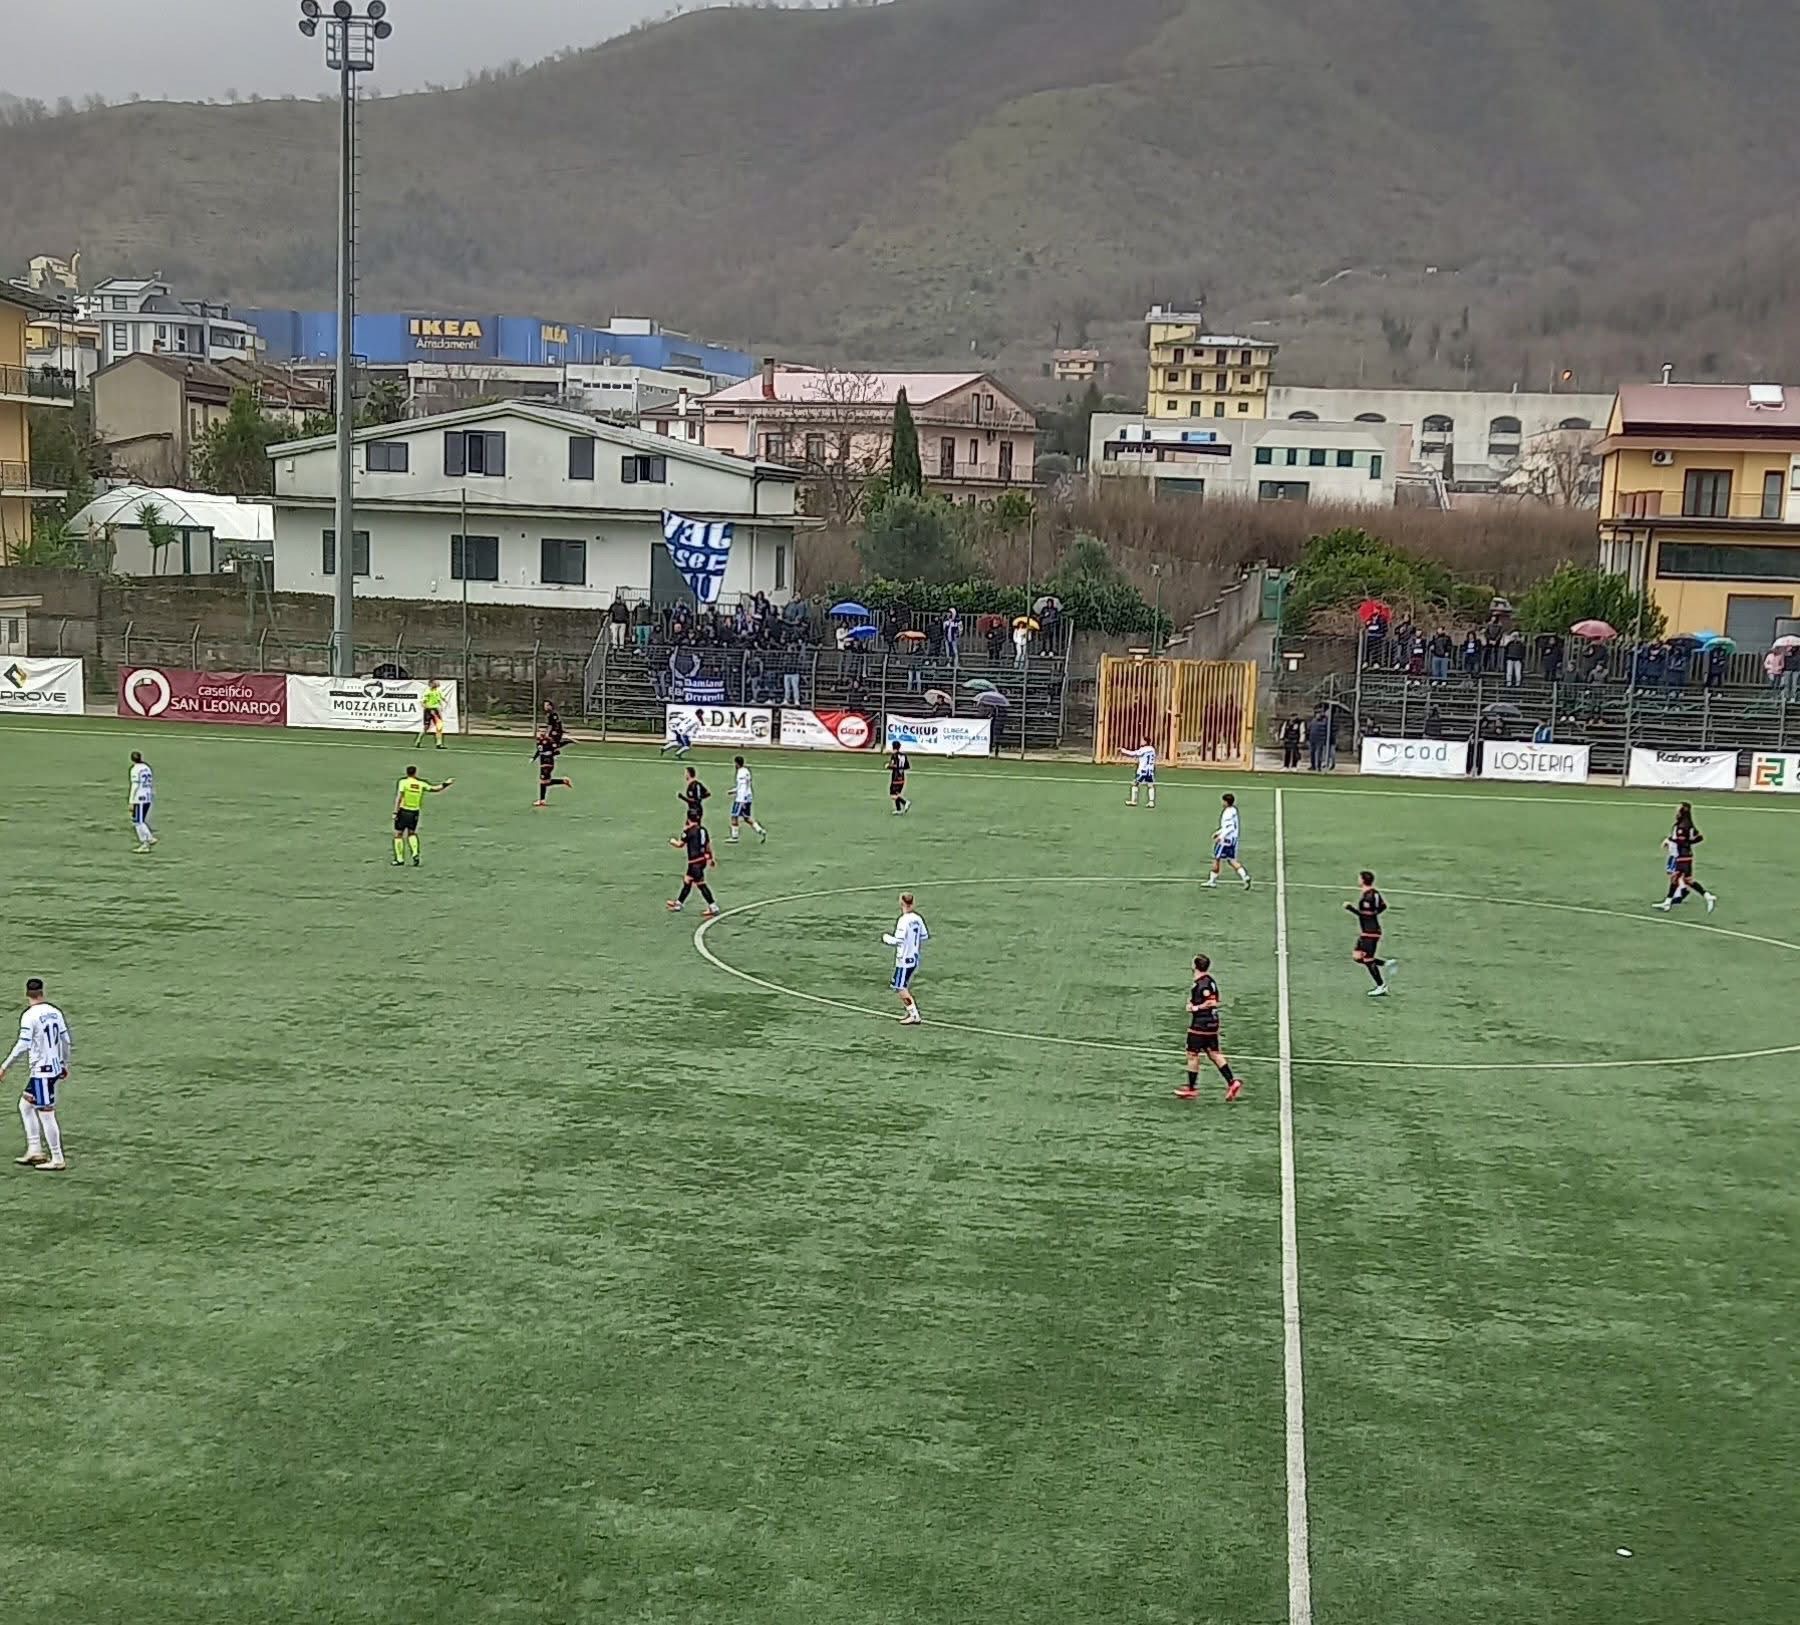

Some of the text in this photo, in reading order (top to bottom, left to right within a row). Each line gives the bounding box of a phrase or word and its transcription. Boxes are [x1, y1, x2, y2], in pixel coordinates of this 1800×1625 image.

[409, 319, 483, 337] IKEA
[541, 325, 569, 343] IKEA
[416, 337, 479, 350] Arredamenti
[198, 685, 253, 698] caseificio
[170, 697, 281, 715] SAN LEONARDO
[333, 699, 417, 713] MOZZARELLA
